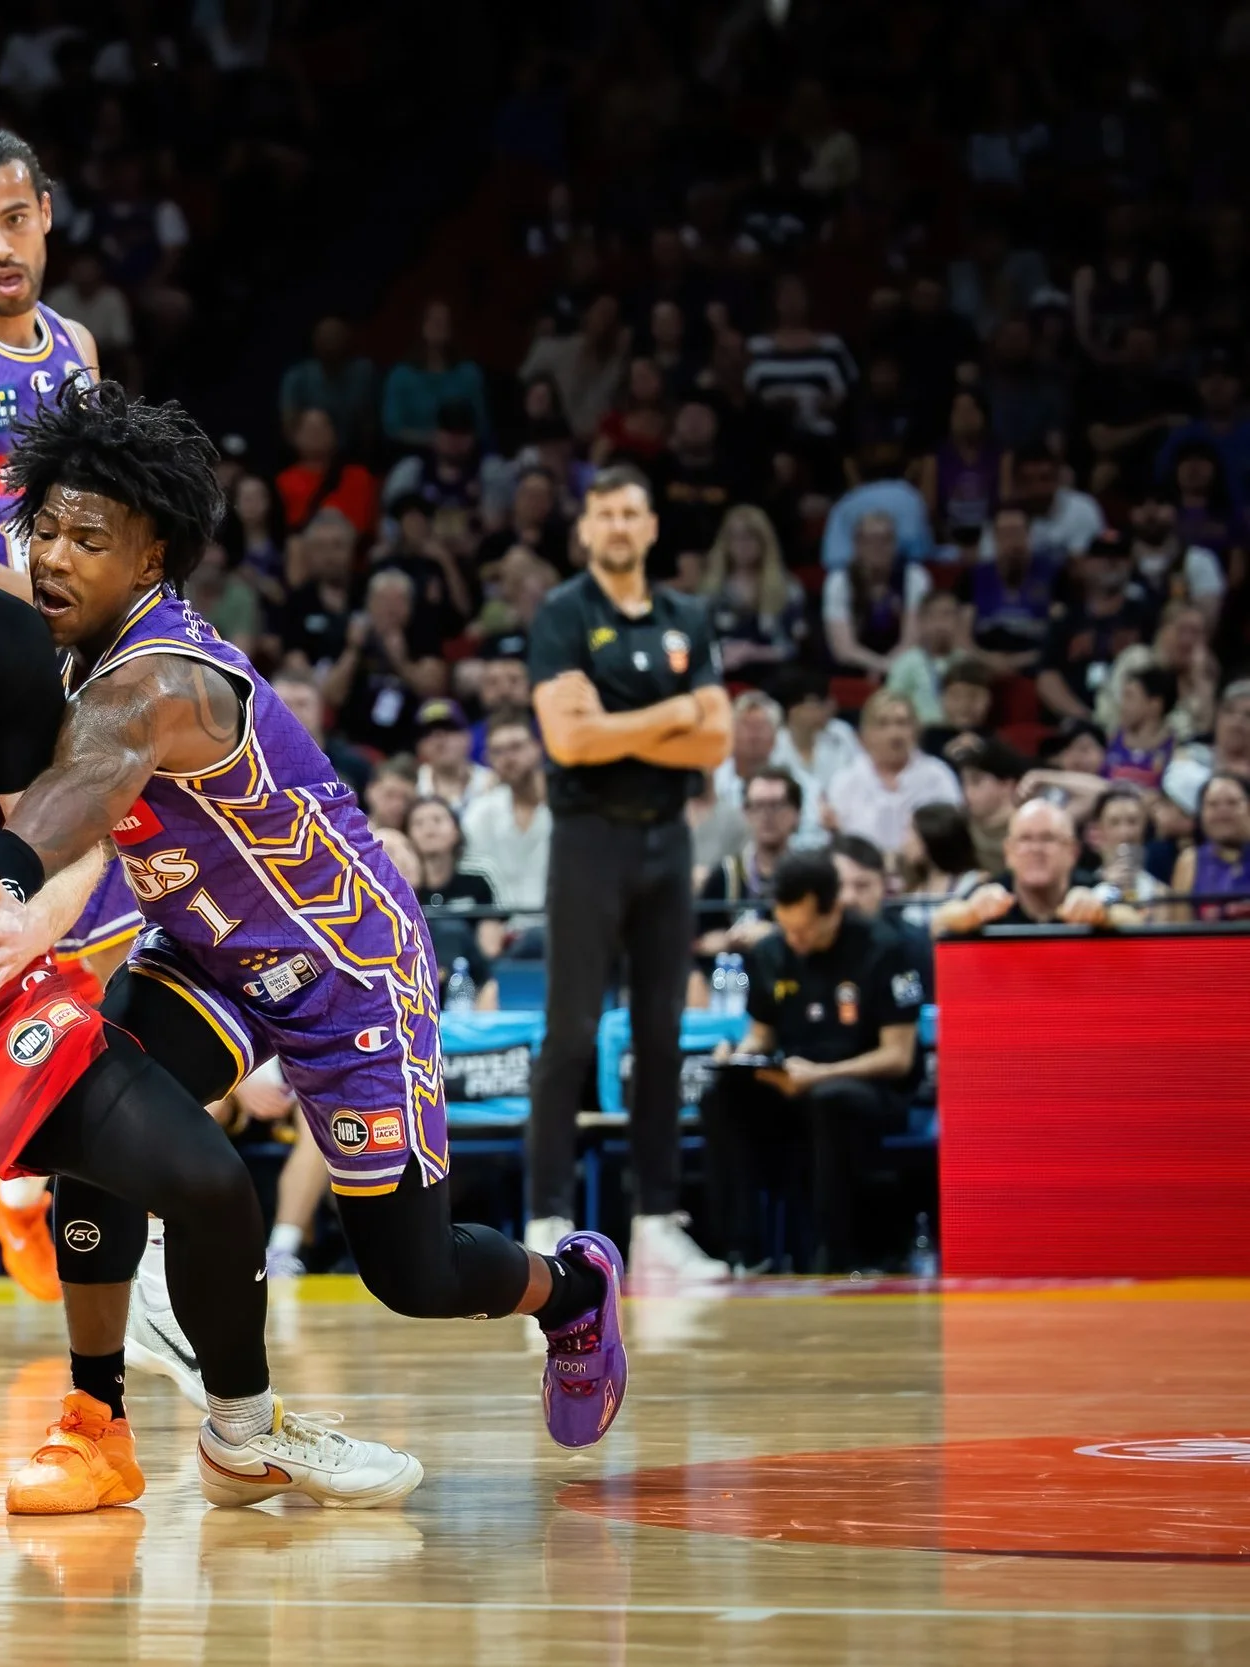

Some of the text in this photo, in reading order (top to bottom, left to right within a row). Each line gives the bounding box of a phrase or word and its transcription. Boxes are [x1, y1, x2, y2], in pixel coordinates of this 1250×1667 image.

[186, 887, 243, 947] 1
[268, 973, 290, 987] SINCE
[275, 980, 290, 991] 1919
[16, 1027, 47, 1058] NBL
[337, 1121, 361, 1142] NBL
[374, 1123, 398, 1132] HUNGRY
[375, 1129, 399, 1138] JACK'S
